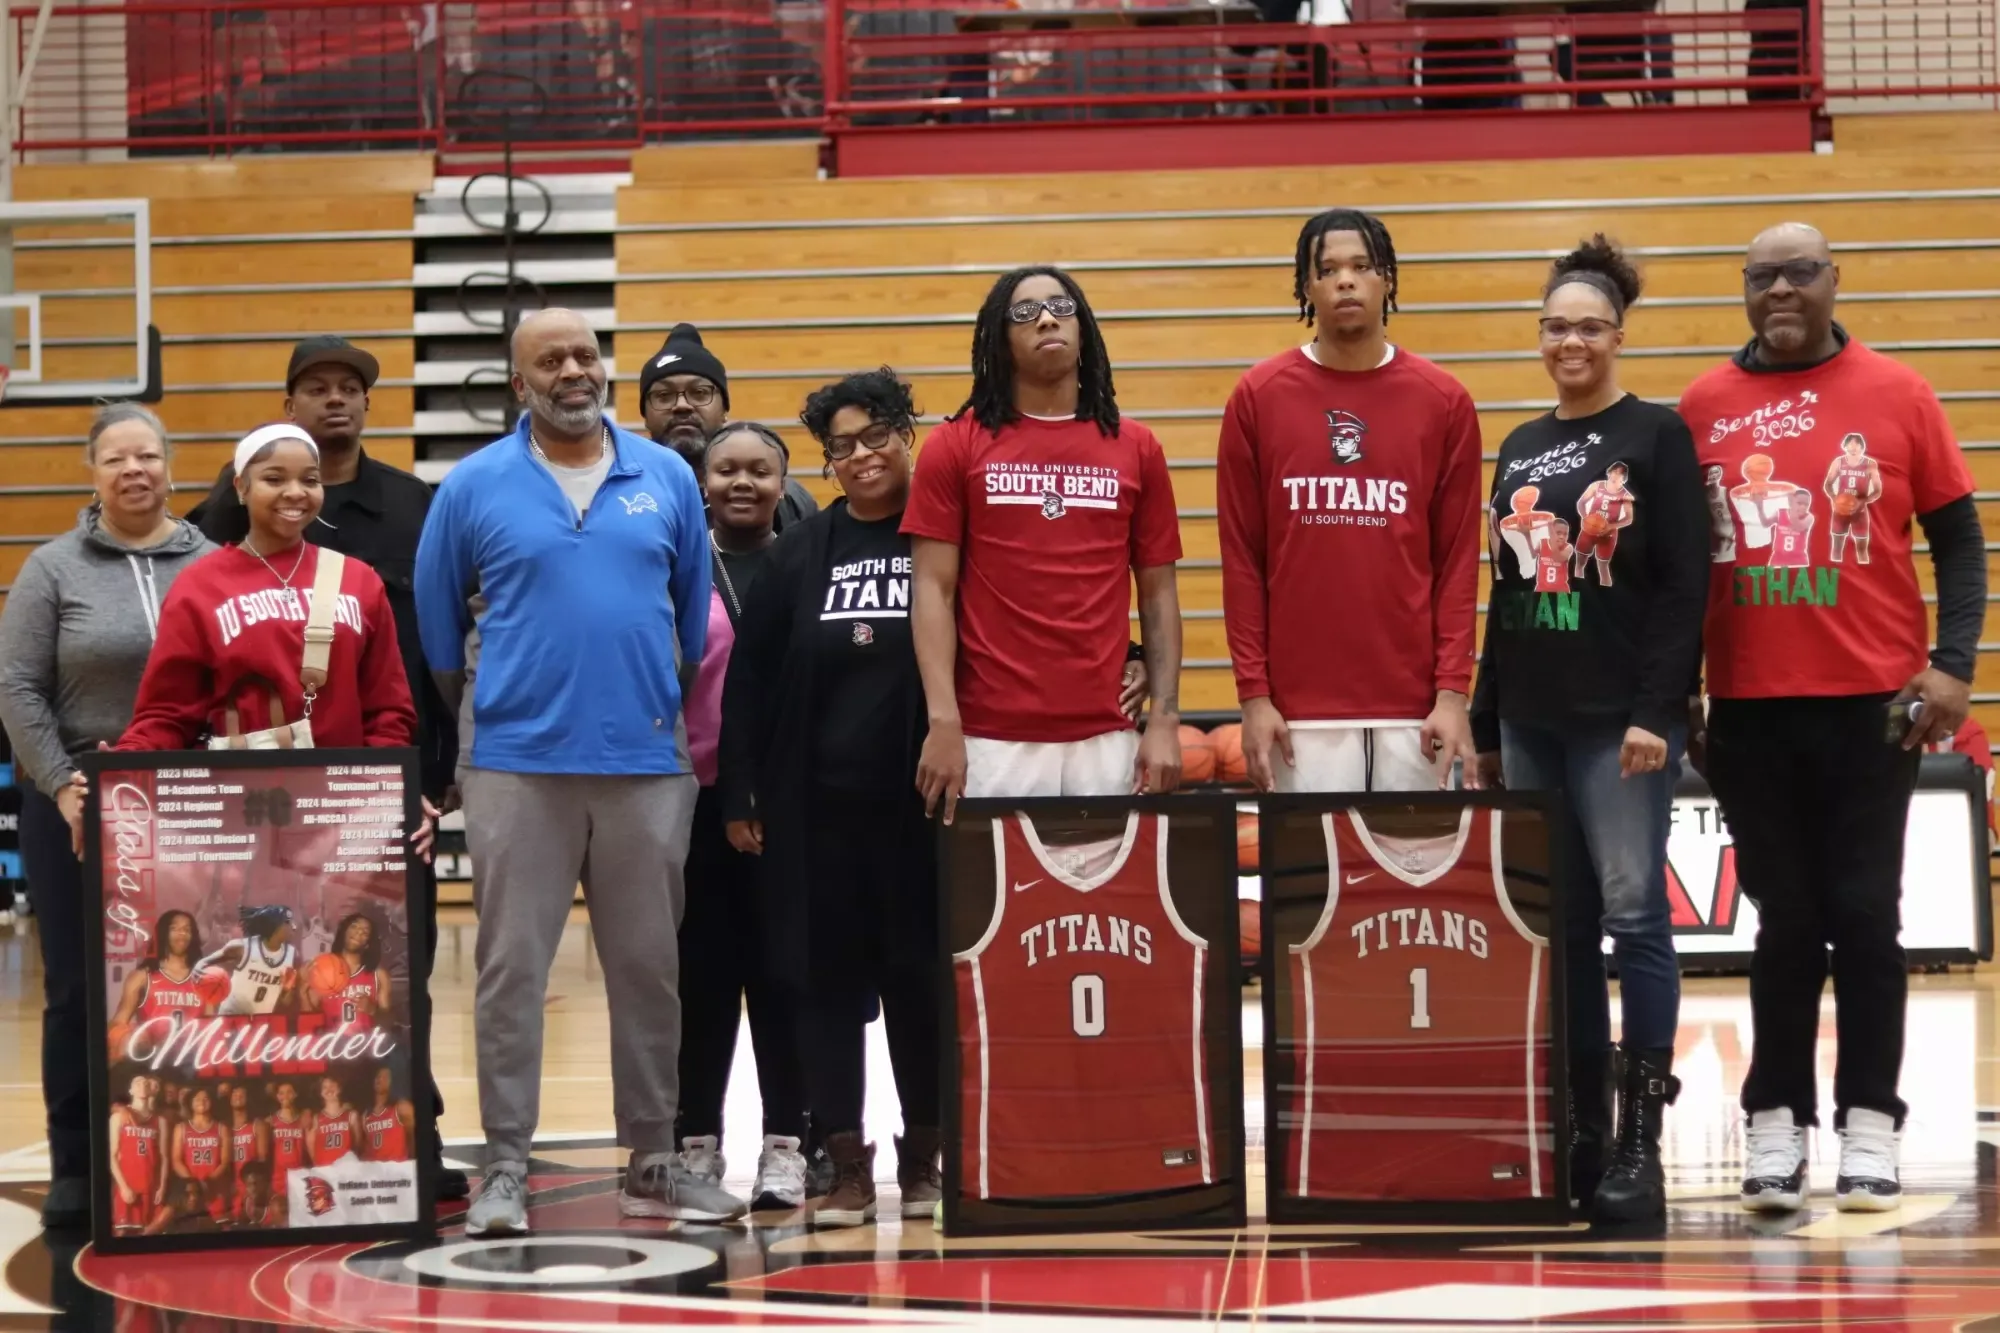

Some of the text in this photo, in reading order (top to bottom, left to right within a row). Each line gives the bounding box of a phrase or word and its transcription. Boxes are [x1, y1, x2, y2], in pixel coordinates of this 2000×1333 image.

[1710, 390, 1819, 444] Senior
[1752, 410, 1815, 447] 2026
[1504, 433, 1604, 481] Senior
[986, 463, 1119, 478] INDIANA UNIVERSITY
[1527, 451, 1587, 483] 2026
[985, 472, 1119, 498] SOUTH BEND
[1282, 477, 1408, 514] TITANS
[1301, 514, 1387, 527] IU SOUTH BEND
[1783, 536, 1794, 551] 8
[831, 558, 886, 581] SOUTH
[1546, 567, 1556, 583] 8
[1734, 565, 1840, 606] ETHAN
[215, 598, 241, 646] IU
[240, 588, 306, 626] SOUTH
[326, 766, 348, 775] 2024
[218, 784, 244, 794] Team
[328, 781, 405, 791] Tournament Team
[158, 801, 224, 812] 2024 Regional
[296, 798, 320, 808] 2024
[158, 819, 223, 829] Championship
[159, 835, 182, 846] 2024
[213, 834, 247, 844] Division
[381, 846, 404, 855] Team
[323, 862, 346, 873] 2025
[384, 861, 407, 871] Team
[1020, 913, 1153, 968] TITANS
[1351, 907, 1488, 959] TITANS
[154, 991, 201, 1008] TITANS
[1409, 966, 1431, 1029] 1
[1070, 973, 1106, 1038] 0
[127, 1015, 396, 1071] Millender
[274, 1128, 302, 1138] TITANS
[320, 1121, 349, 1134] TITANS
[366, 1118, 393, 1133] TITANS
[187, 1137, 218, 1148] TITANS
[192, 1150, 213, 1165] 24
[338, 1179, 411, 1190] Indiana University
[350, 1196, 374, 1206] South
